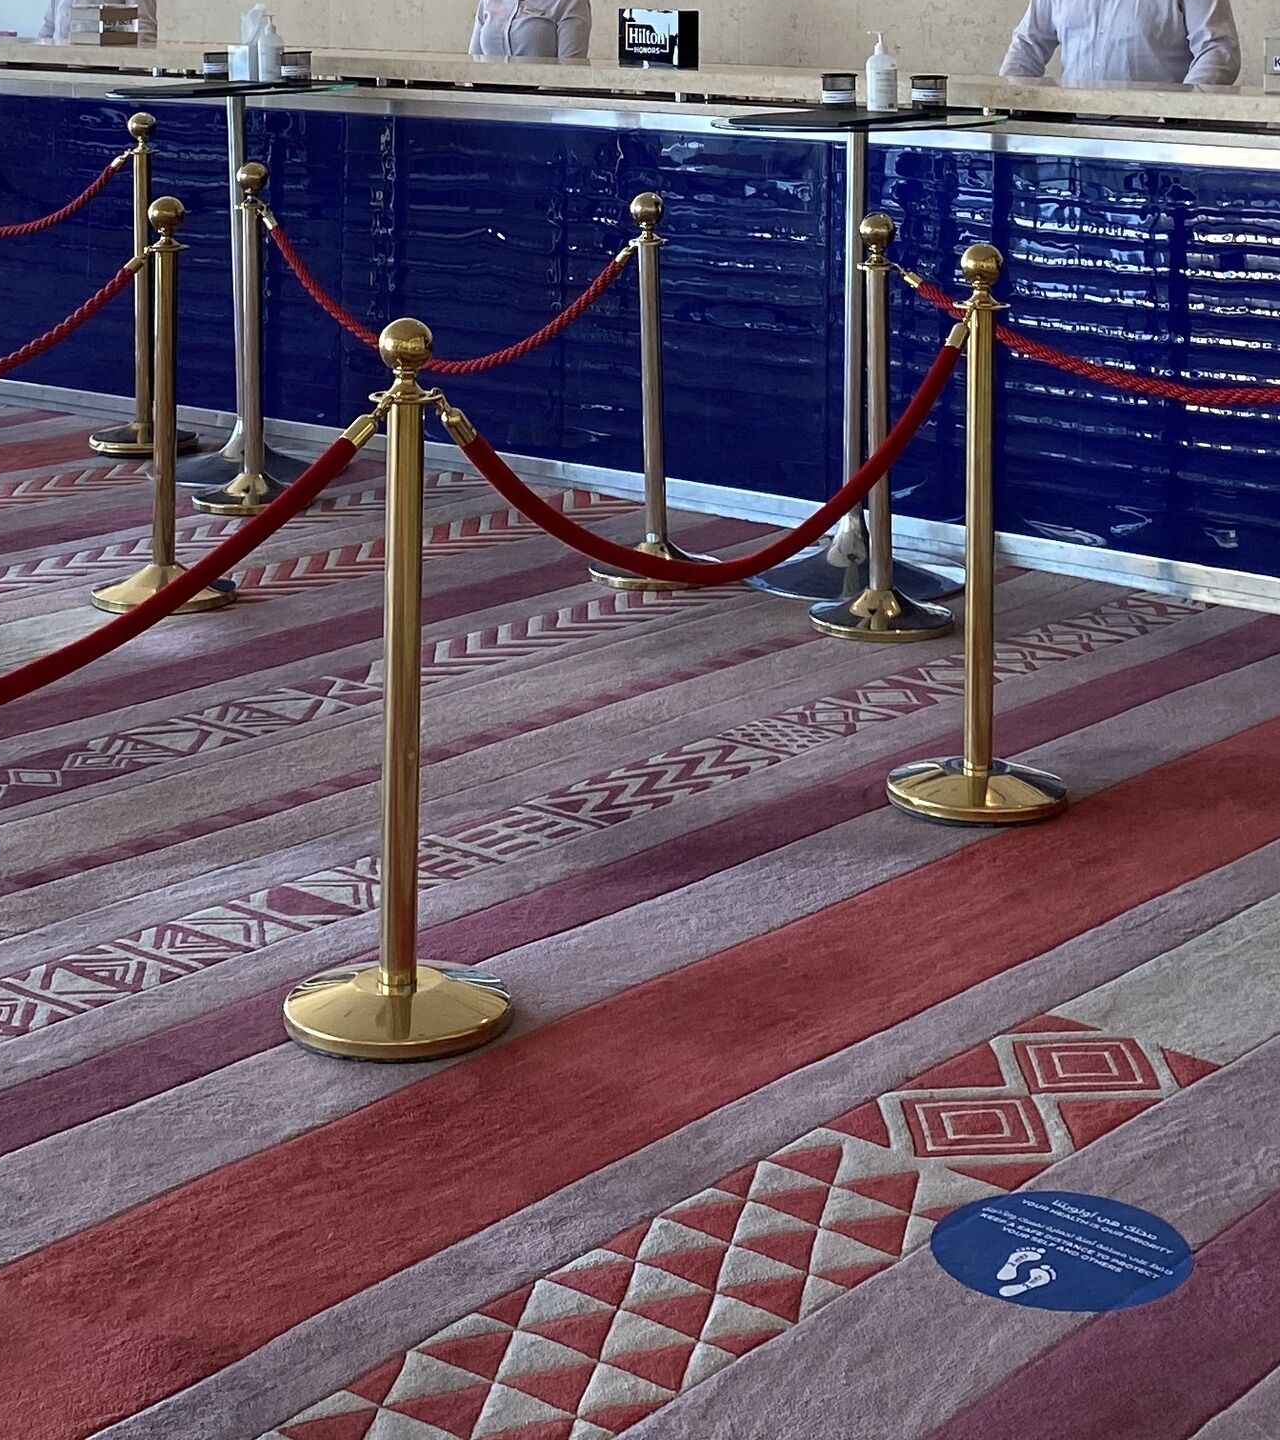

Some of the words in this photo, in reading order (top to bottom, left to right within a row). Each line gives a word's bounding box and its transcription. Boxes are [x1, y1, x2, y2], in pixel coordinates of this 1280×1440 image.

[628, 27, 665, 45] Hilton
[633, 46, 660, 55] HONORS
[979, 1212, 1008, 1224] KEEP
[1016, 1224, 1045, 1237] SAFE
[1043, 1234, 1097, 1255] DISTANCE
[1096, 1251, 1111, 1261] TO
[1110, 1258, 1161, 1280] PROTECT
[1002, 1226, 1031, 1240] YOUR
[1030, 1235, 1057, 1248] SELF
[1055, 1245, 1080, 1258] AND
[1080, 1254, 1124, 1273] OTHERS
[1022, 1199, 1050, 1212] YOUR
[1049, 1208, 1089, 1225] HEALTH
[1088, 1222, 1101, 1230] IS
[1100, 1226, 1124, 1238] OUR
[1123, 1234, 1175, 1254] PRIORITY
